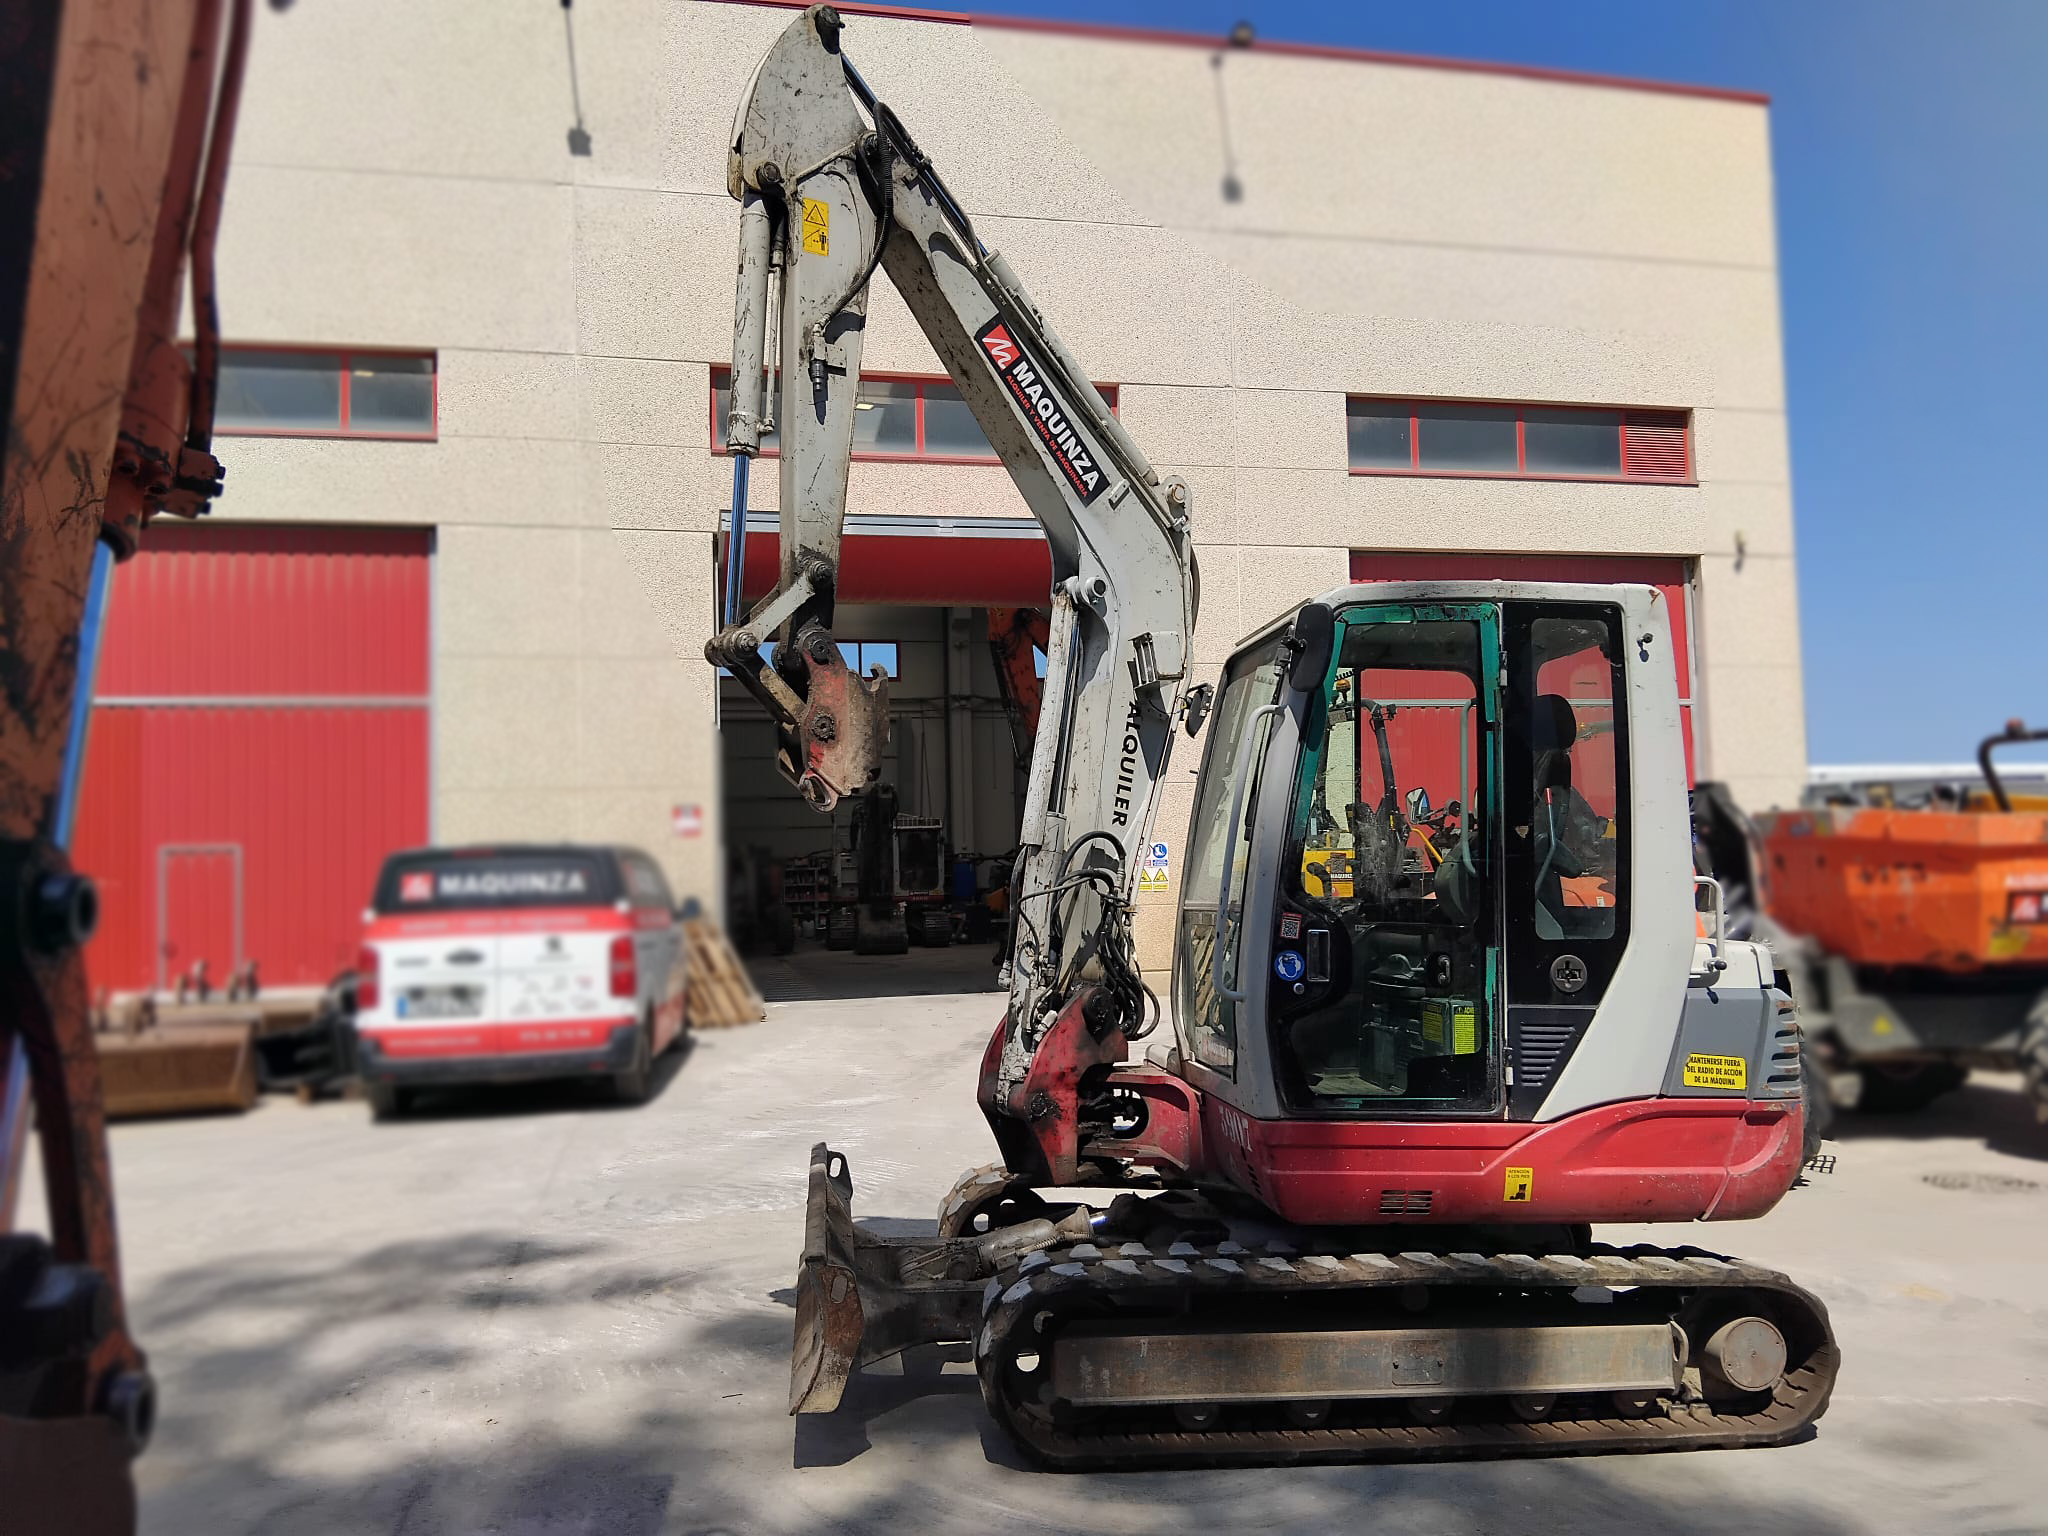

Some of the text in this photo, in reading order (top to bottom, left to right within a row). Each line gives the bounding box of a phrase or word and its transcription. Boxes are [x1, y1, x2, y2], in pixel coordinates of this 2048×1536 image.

[1006, 375, 1031, 410] ALQUILER
[1034, 415, 1050, 441] VENTA
[1049, 439, 1058, 451] DE
[1055, 450, 1088, 498] MAQUINARIA
[1012, 360, 1099, 492] MAQUINZA
[1112, 700, 1140, 827] ALQUILER
[440, 872, 586, 894] MAQUINZA
[1686, 1065, 1697, 1073] DEL
[1697, 1066, 1715, 1075] RADIO
[1715, 1067, 1723, 1076] DE
[1690, 1056, 1741, 1067] MANTENERSE FUERA
[1694, 1075, 1702, 1083] DE
[1702, 1076, 1709, 1084] LA
